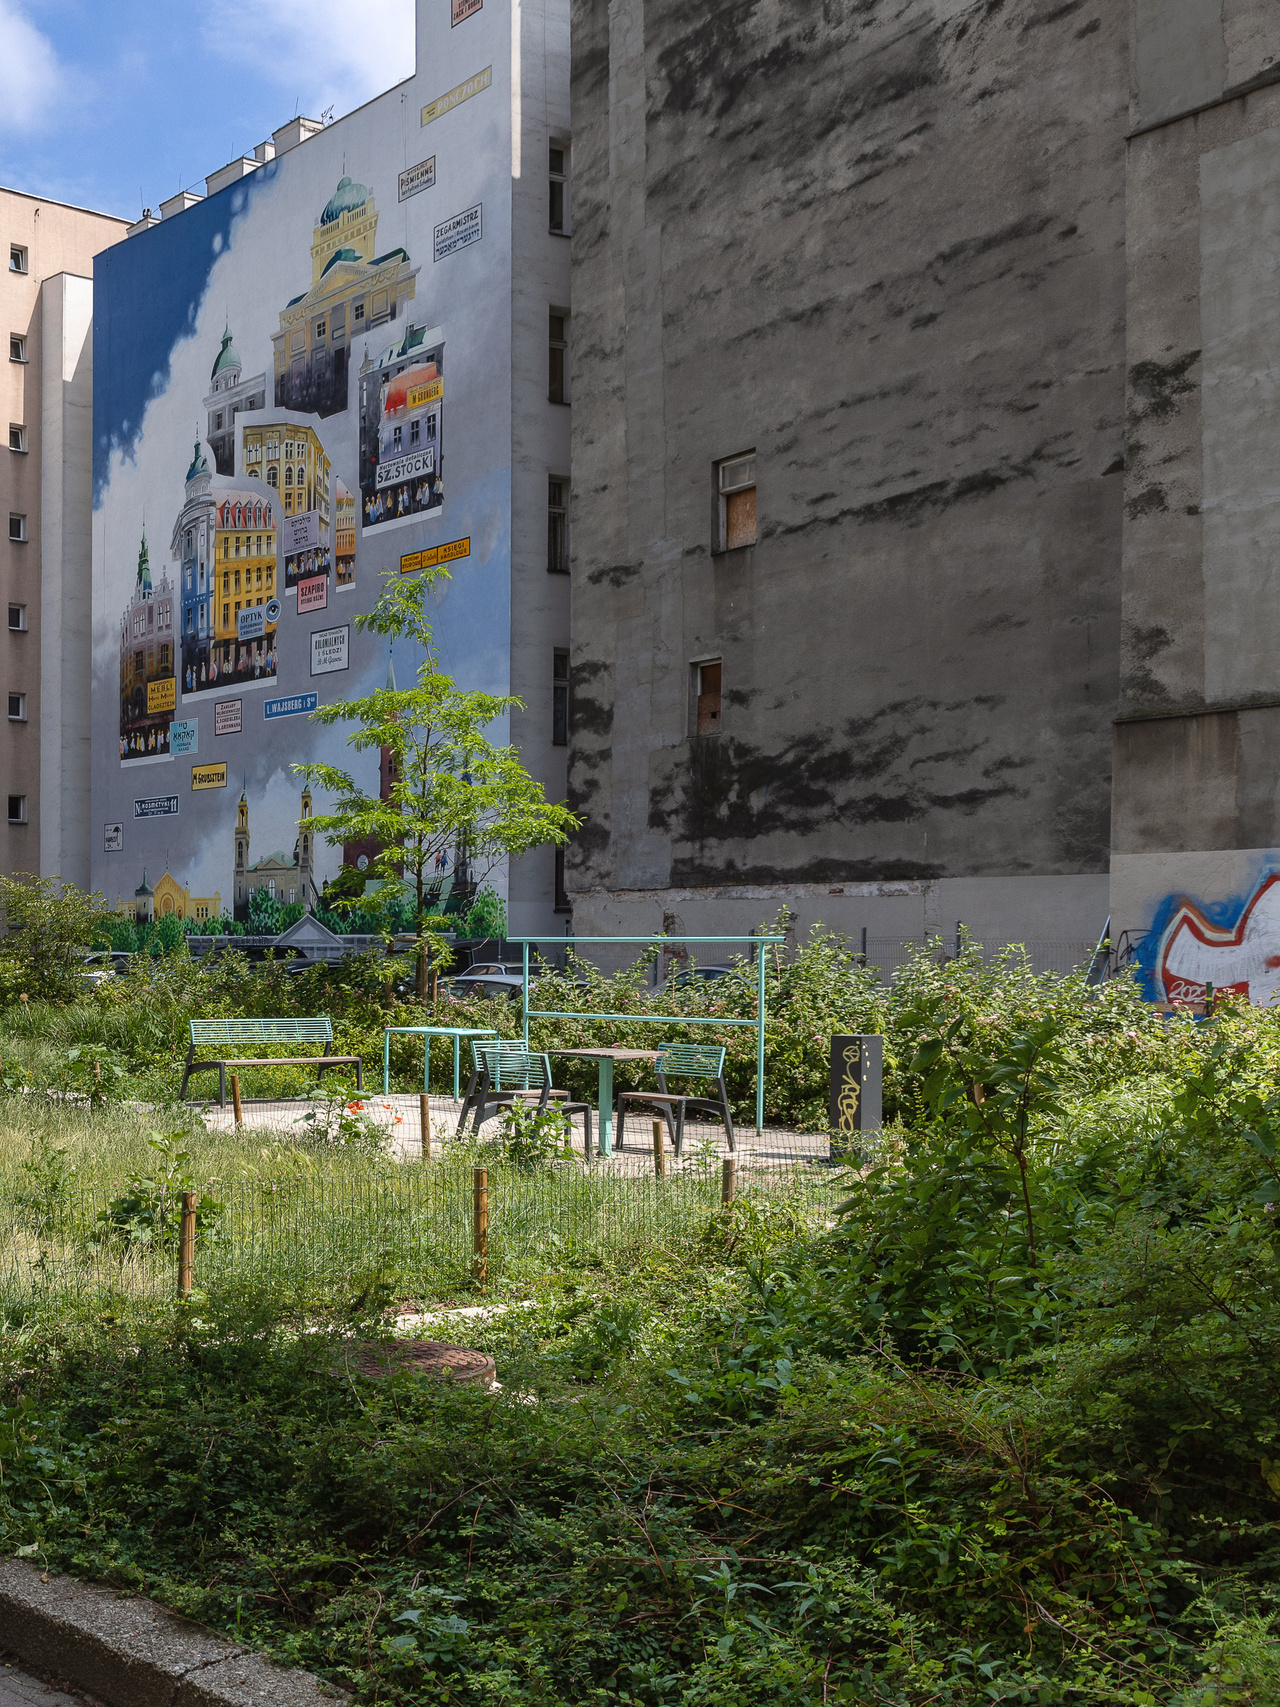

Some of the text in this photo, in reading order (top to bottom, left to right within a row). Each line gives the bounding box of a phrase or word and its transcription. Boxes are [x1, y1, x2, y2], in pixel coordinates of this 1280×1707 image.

[437, 73, 488, 114] PONCZOCH
[436, 210, 479, 239] ZEGARMISTRZ
[377, 454, 433, 484] SZ.STOCKI
[300, 582, 325, 598] SZAPIRO
[240, 611, 263, 624] OPTYK
[150, 683, 173, 695] MEBLI
